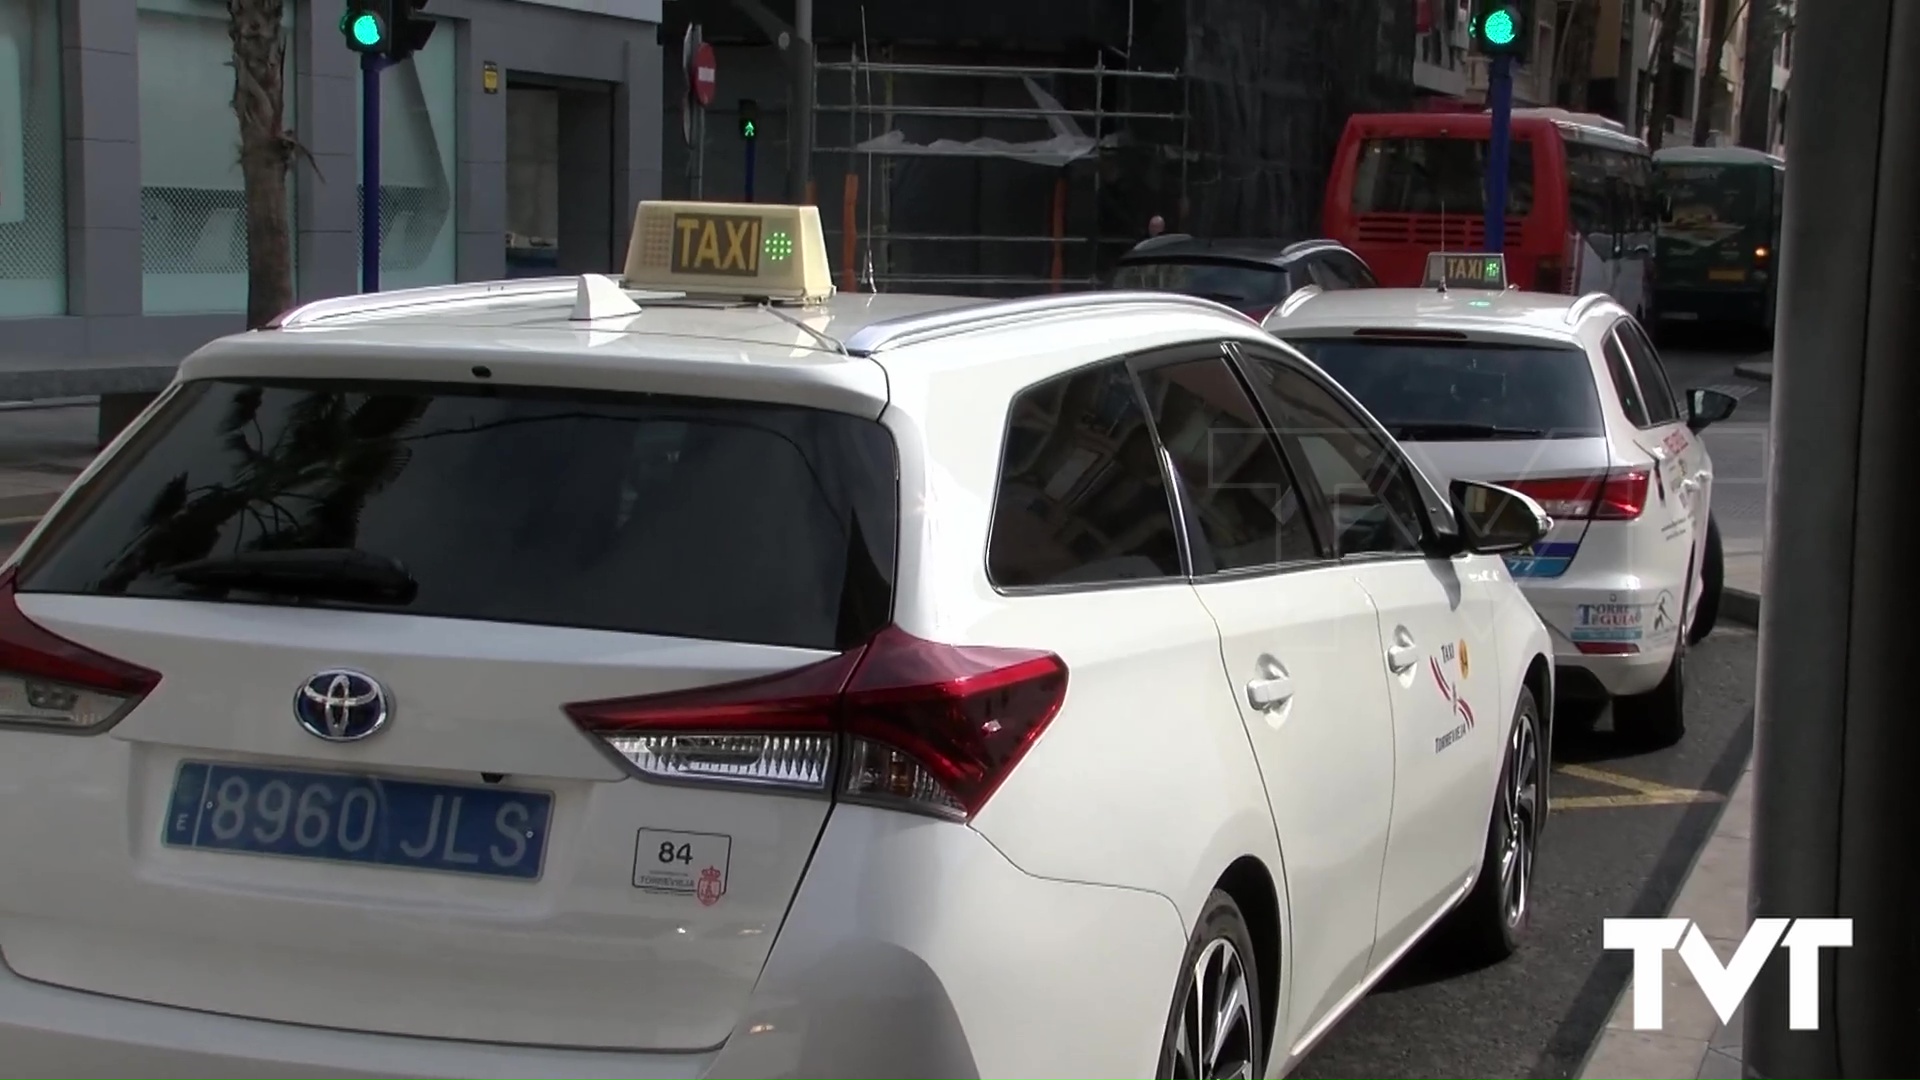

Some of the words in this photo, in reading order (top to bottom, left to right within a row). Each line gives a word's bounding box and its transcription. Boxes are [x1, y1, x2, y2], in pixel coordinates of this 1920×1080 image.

[676, 218, 759, 271] TAXI
[1447, 258, 1483, 279] TAXI
[1441, 642, 1455, 664] TAXI
[211, 775, 377, 852] 8960
[400, 794, 530, 867] JLS
[658, 841, 693, 865] 84
